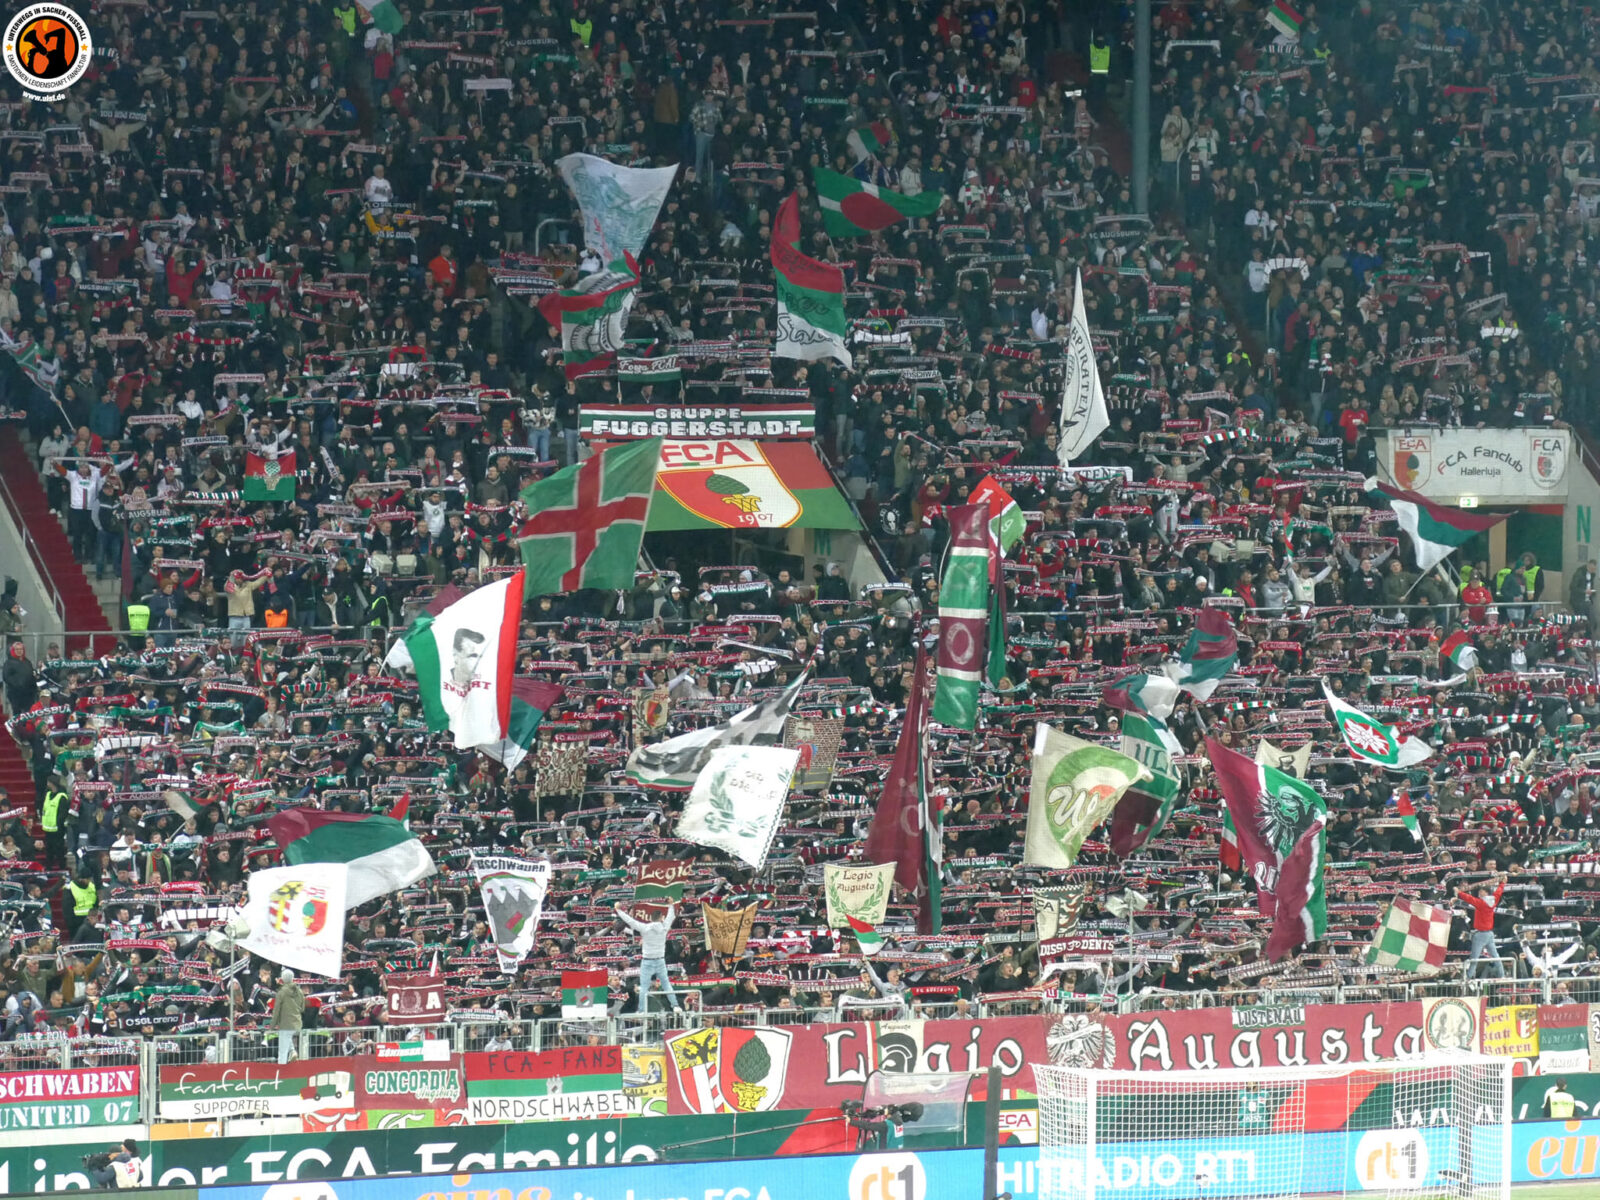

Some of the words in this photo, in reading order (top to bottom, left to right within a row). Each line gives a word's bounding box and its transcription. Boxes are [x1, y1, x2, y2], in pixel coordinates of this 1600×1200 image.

[651, 357, 677, 370] FCA!
[654, 407, 742, 420] GRUPPE
[592, 420, 802, 436] FUGGERSTADT
[660, 441, 754, 465] FCA
[1533, 439, 1562, 451] FCA
[1437, 450, 1468, 476] FCA
[1473, 446, 1523, 474] Fanclub
[738, 513, 774, 525] 1907
[1576, 505, 1592, 543] N
[843, 870, 874, 882] Legio
[837, 882, 875, 893] Augusta
[1081, 939, 1115, 950] DENTS
[153, 1015, 179, 1025] arena
[1236, 1005, 1302, 1026] LUSTENAU
[1127, 1011, 1424, 1071] Augusta
[488, 1053, 533, 1073] FCA
[563, 1049, 618, 1069] FANS
[0, 1070, 134, 1098] SCHWABEN
[174, 1067, 284, 1095] fanfahrt
[365, 1069, 460, 1094] CONCORDIA
[415, 1087, 460, 1102] Augsburg
[0, 1104, 91, 1129] UNITED
[103, 1101, 134, 1123] 07
[194, 1099, 270, 1115] SUPPORTER
[472, 1093, 636, 1118] NORDSCHWABEN
[1366, 1140, 1417, 1181] rt1
